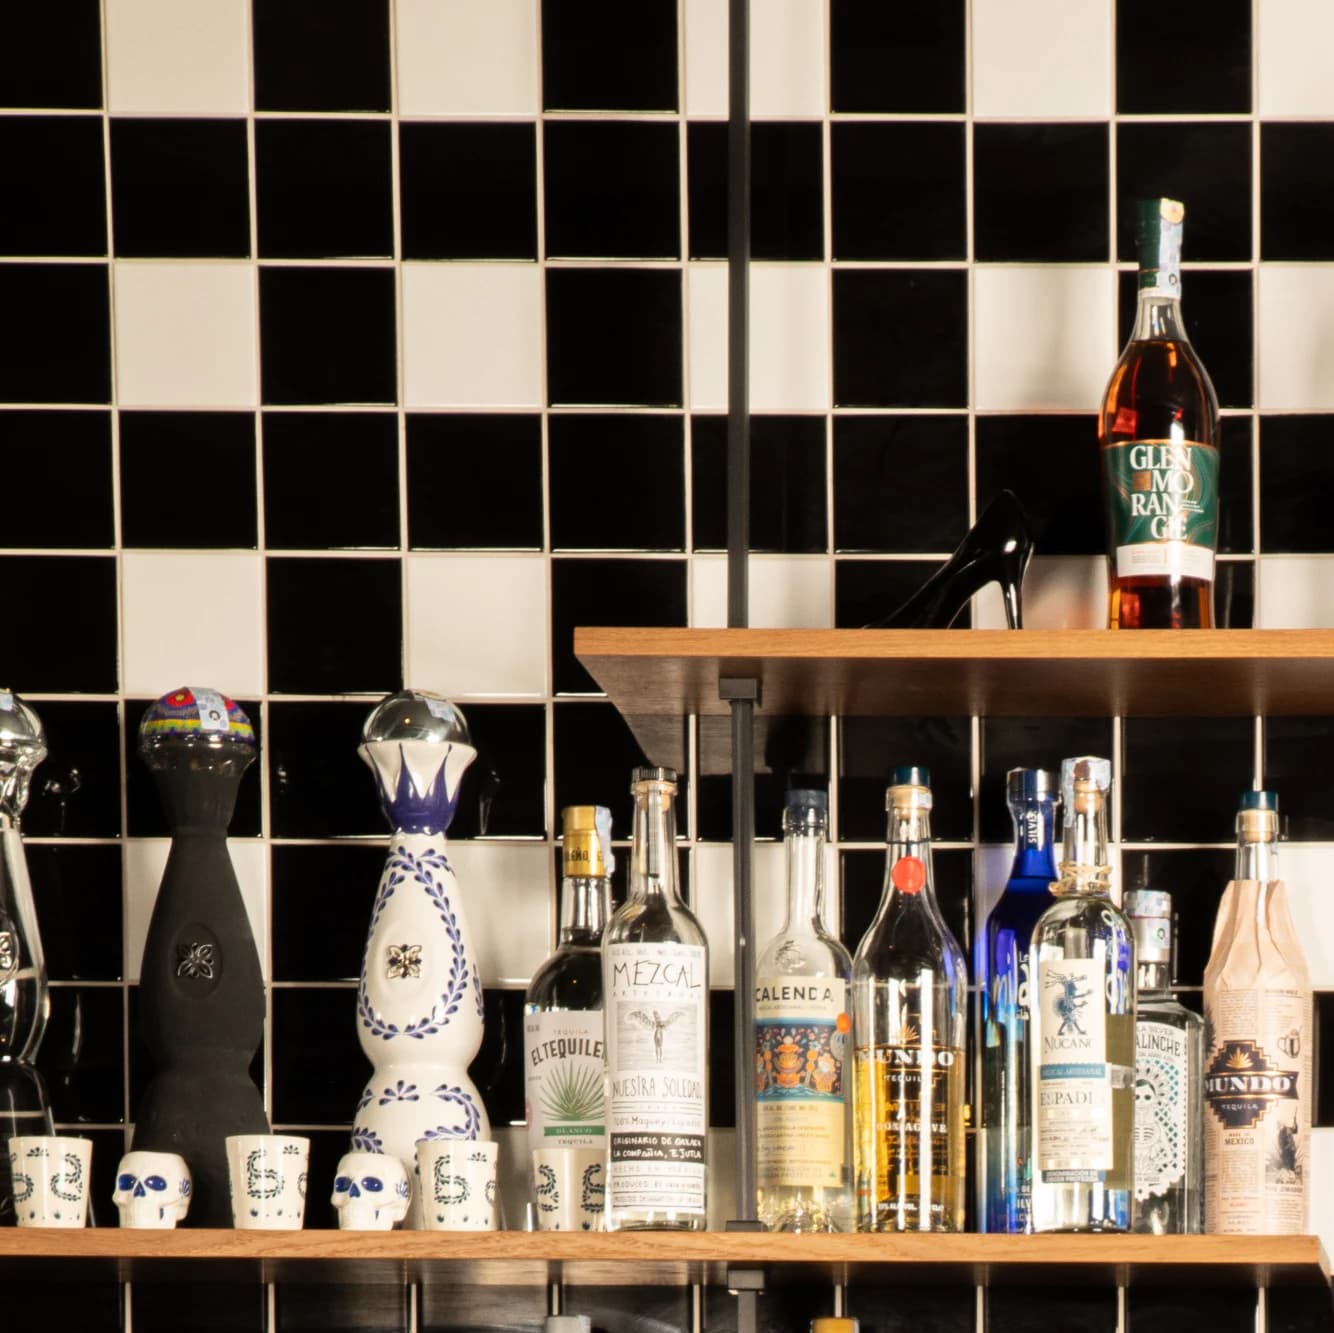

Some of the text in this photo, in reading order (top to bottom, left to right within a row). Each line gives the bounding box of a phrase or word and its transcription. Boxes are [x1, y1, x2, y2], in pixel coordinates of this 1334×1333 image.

[1130, 445, 1192, 471] GLEN
[1152, 470, 1194, 494] MO
[1151, 515, 1188, 540] GIE
[612, 960, 702, 989] MEZCAL
[756, 986, 833, 1002] CALENDA
[1136, 1033, 1181, 1057] ALINCHE
[857, 1049, 954, 1068] MUNDO
[612, 1074, 656, 1099] NUESTRA
[1205, 1075, 1291, 1093] MUNDO
[661, 1136, 672, 1146] DE
[1225, 1138, 1255, 1146] MEXICO
